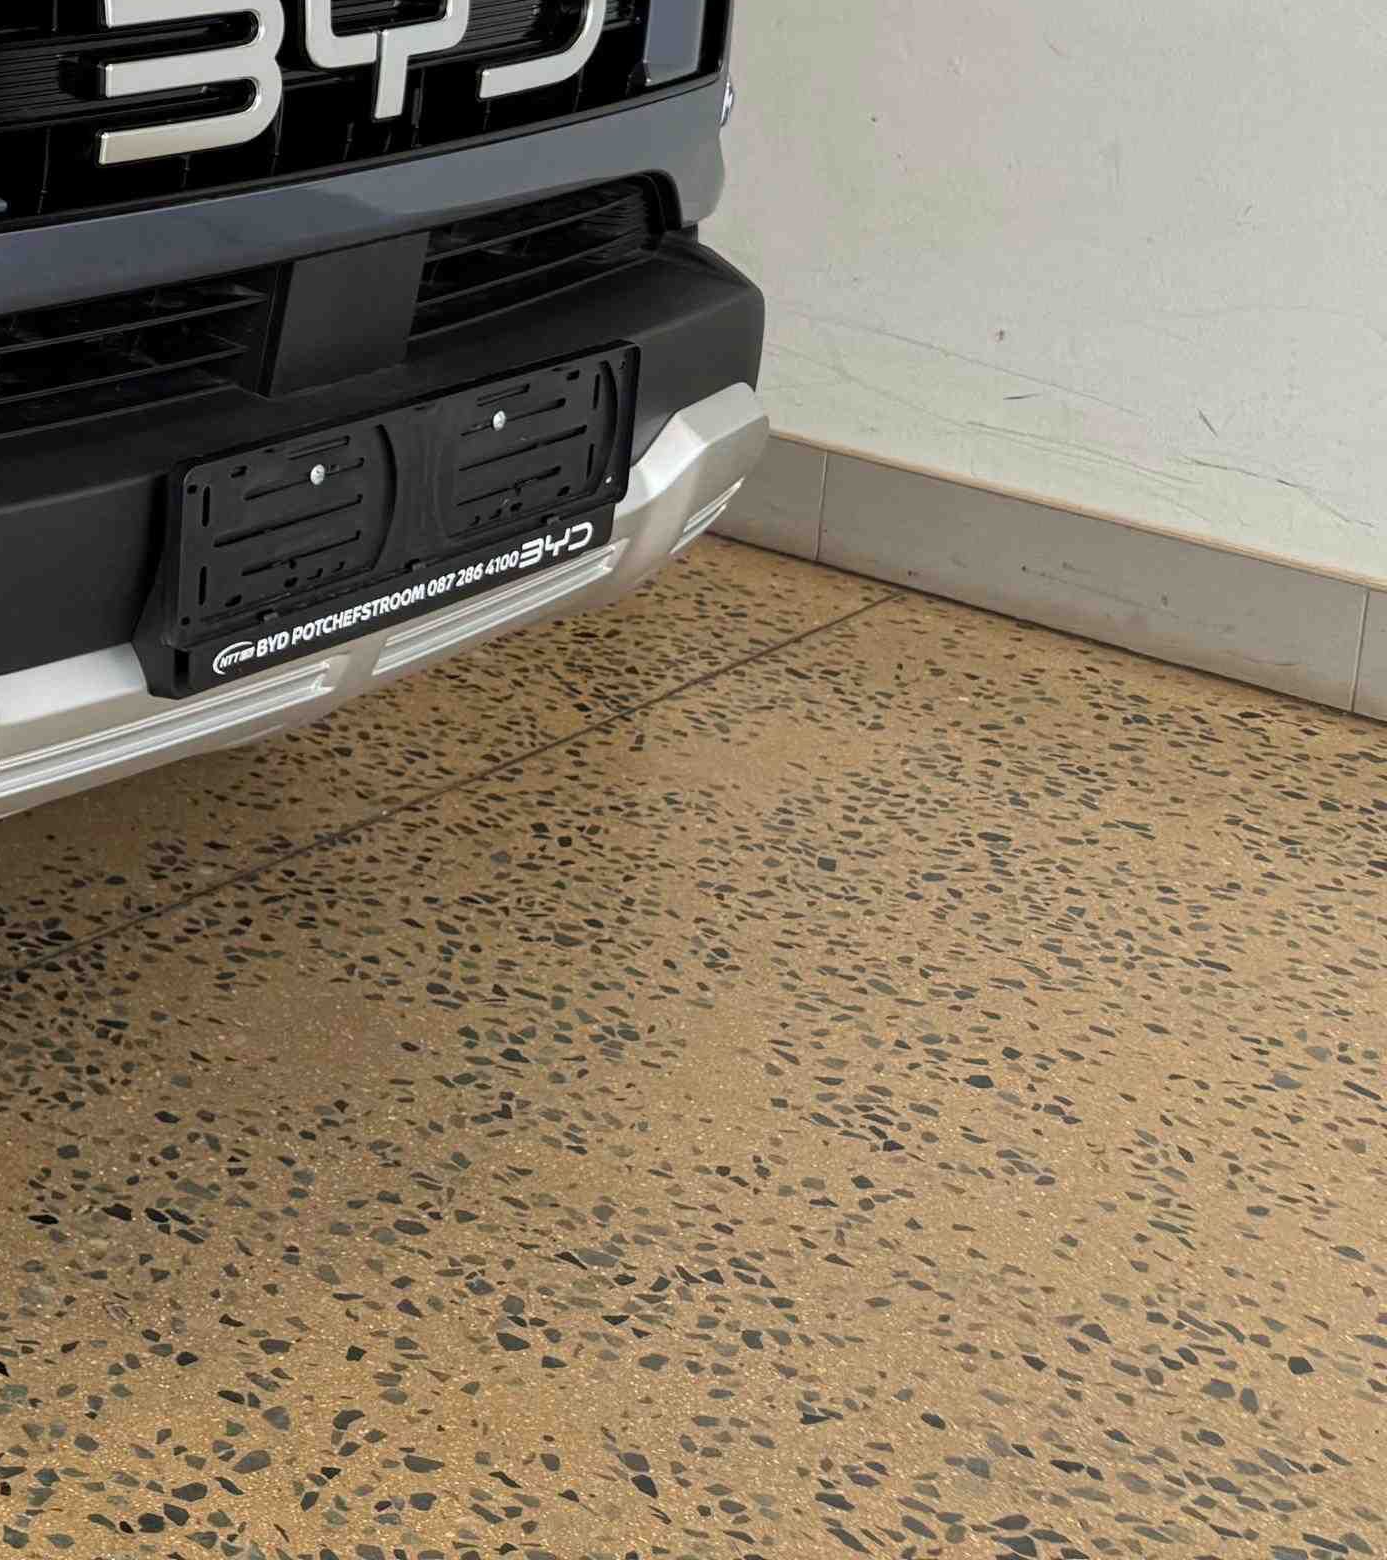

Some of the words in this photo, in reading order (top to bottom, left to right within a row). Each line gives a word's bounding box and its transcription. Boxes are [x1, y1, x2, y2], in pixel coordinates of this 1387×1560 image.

[256, 631, 289, 658] BYD
[291, 582, 425, 646] POTCHEFSTROOM
[427, 572, 456, 597] 087
[456, 562, 484, 587] 286
[484, 550, 520, 576] 4100
[519, 521, 594, 569] BYD
